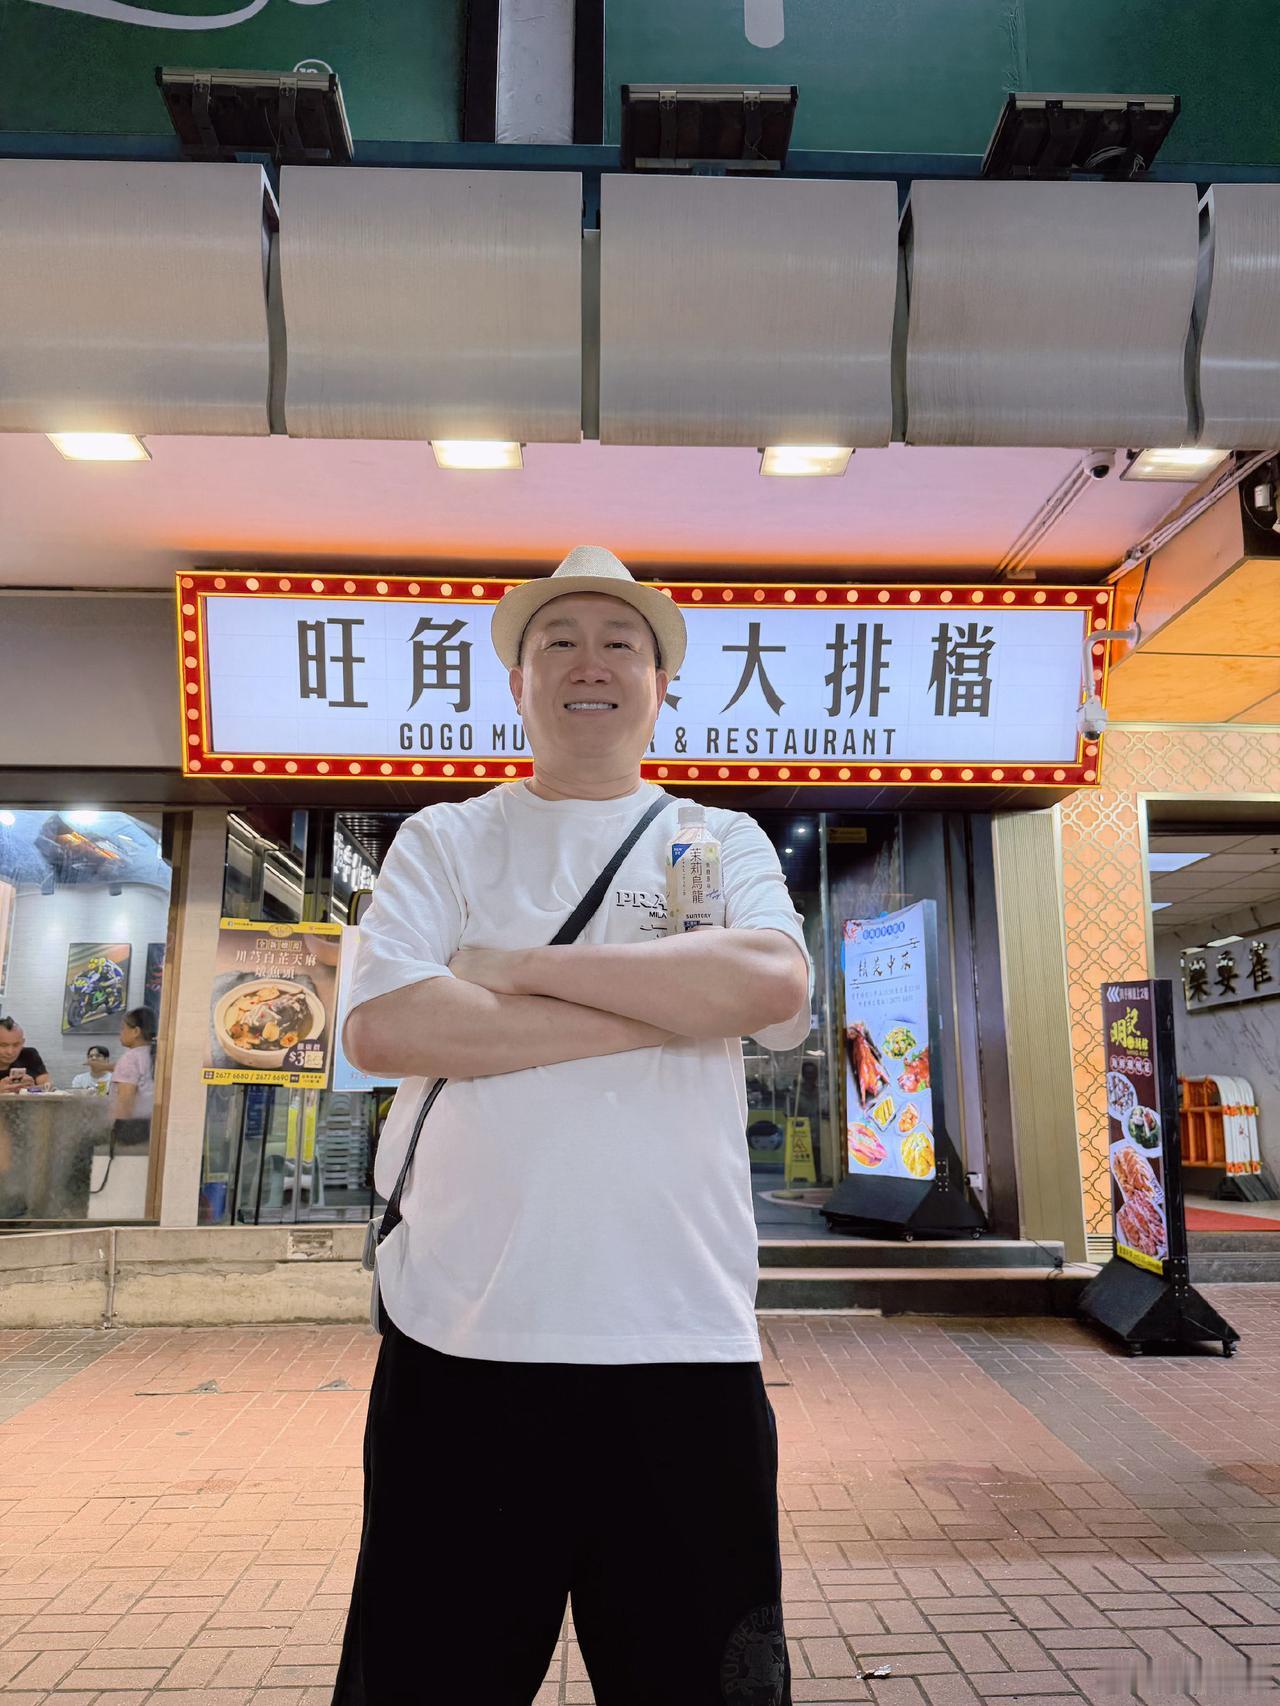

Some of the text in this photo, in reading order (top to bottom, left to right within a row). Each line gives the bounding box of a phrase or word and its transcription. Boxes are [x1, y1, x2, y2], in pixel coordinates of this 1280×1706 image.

[297, 617, 996, 718] 旺角大排檔
[399, 723, 473, 751] GOGO
[674, 726, 688, 753] &
[706, 727, 897, 756] RESTAURANT
[690, 847, 704, 905] 茉莉烏龍
[616, 890, 668, 911] PRA
[648, 911, 667, 920] MILA
